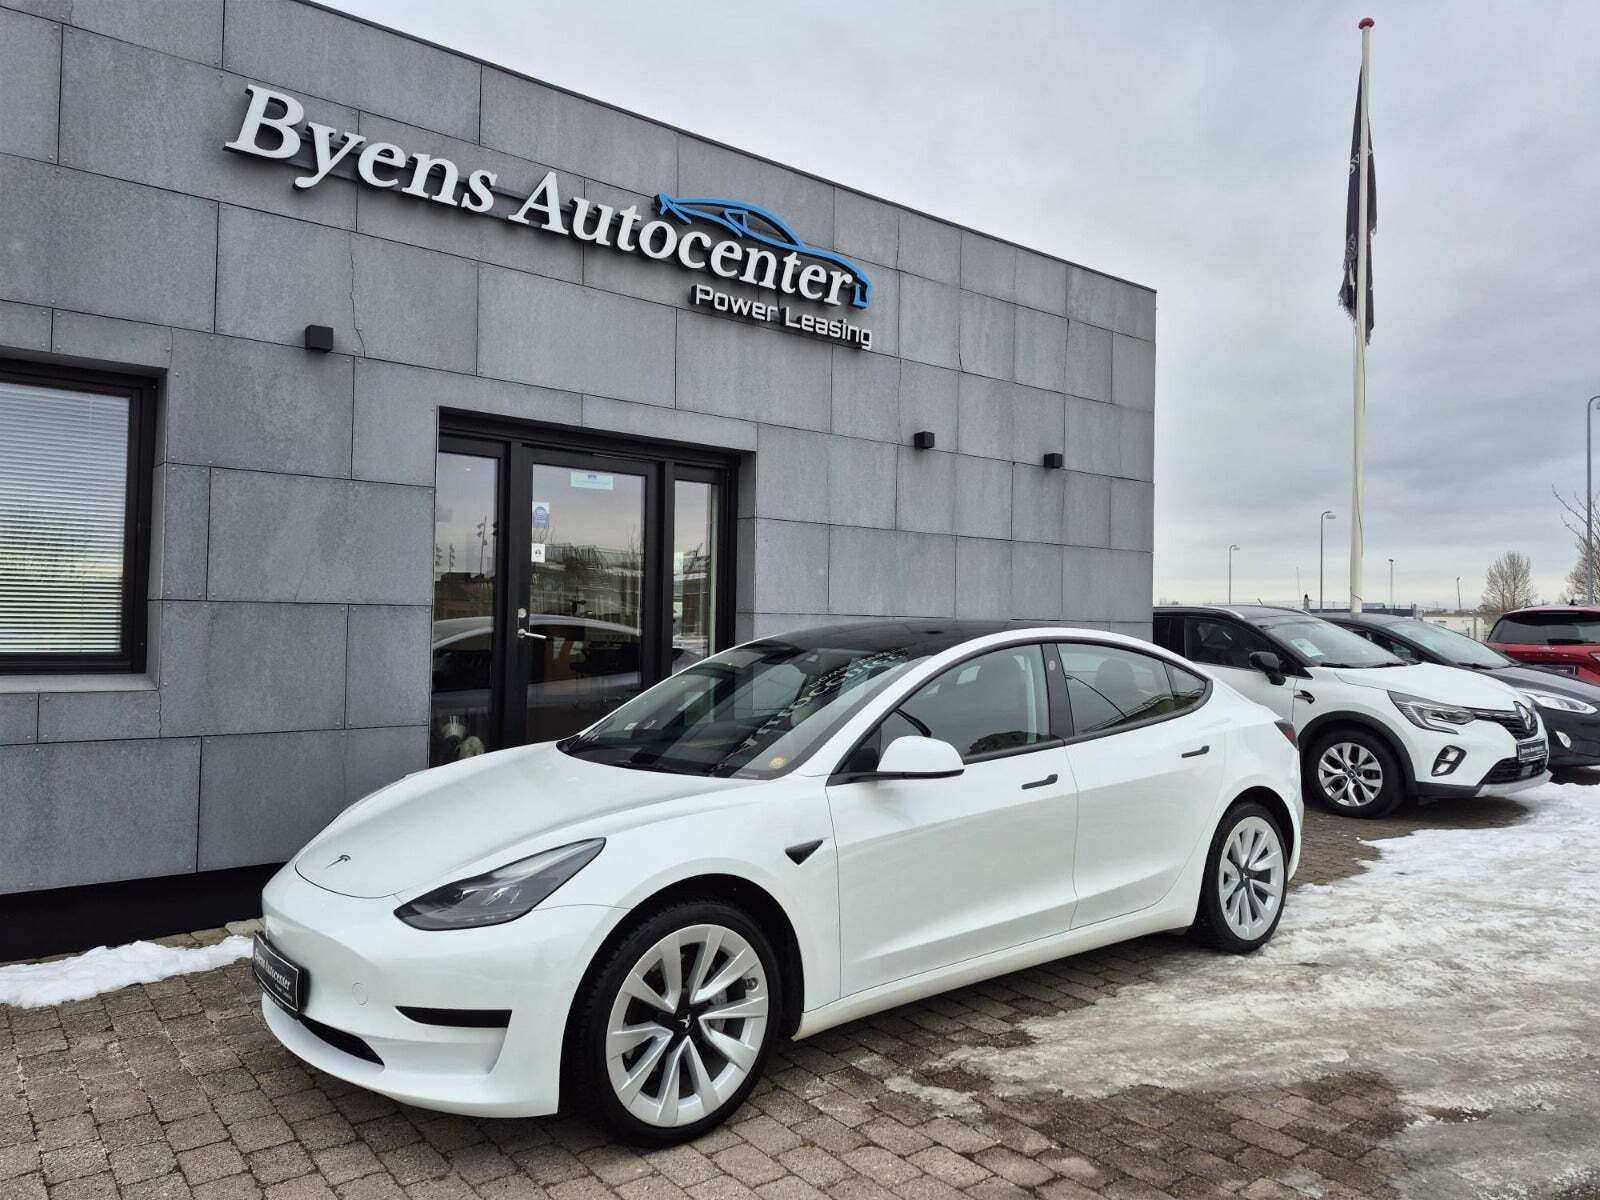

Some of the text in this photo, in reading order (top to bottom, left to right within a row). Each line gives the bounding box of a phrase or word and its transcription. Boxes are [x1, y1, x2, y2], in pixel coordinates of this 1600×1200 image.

[225, 83, 853, 306] Byens Autocenter
[695, 283, 873, 351] Power Leasing
